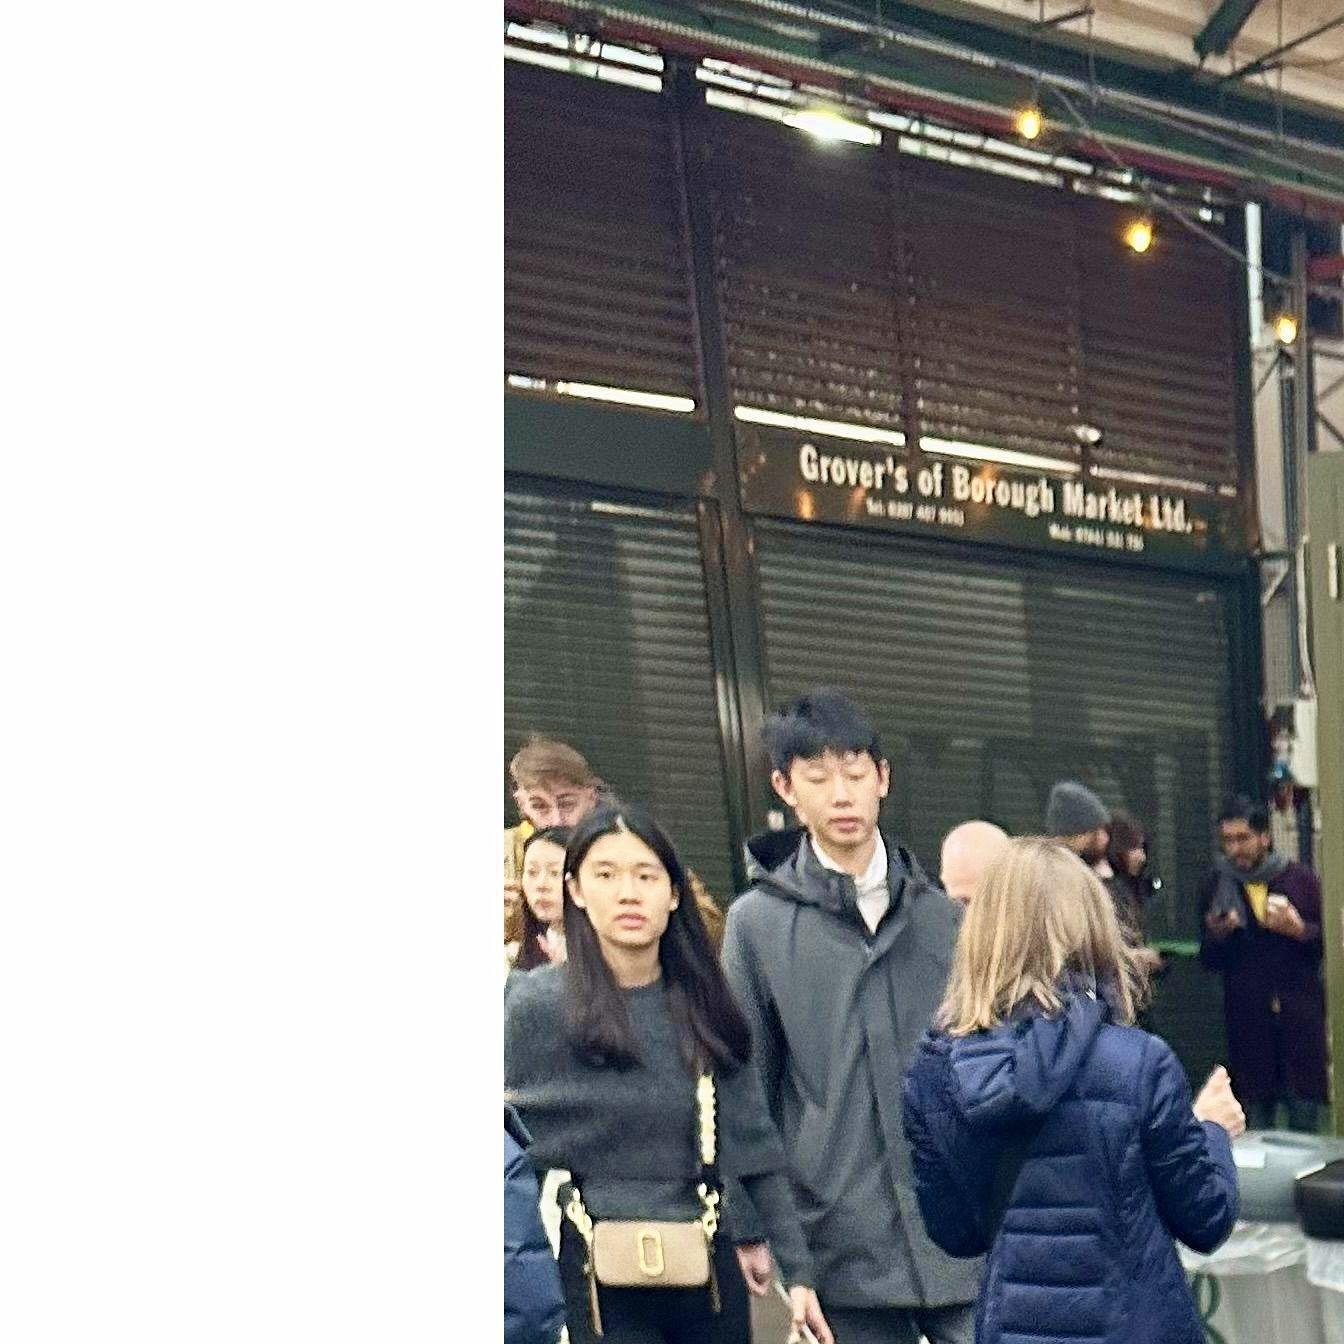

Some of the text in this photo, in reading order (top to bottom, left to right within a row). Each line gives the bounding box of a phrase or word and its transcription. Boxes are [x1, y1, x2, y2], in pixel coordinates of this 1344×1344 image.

[800, 444, 909, 493] Grover's
[918, 462, 944, 498] of
[952, 465, 1055, 517] Borough
[1062, 480, 1144, 526] Market
[1151, 494, 1193, 533] Ltd.
